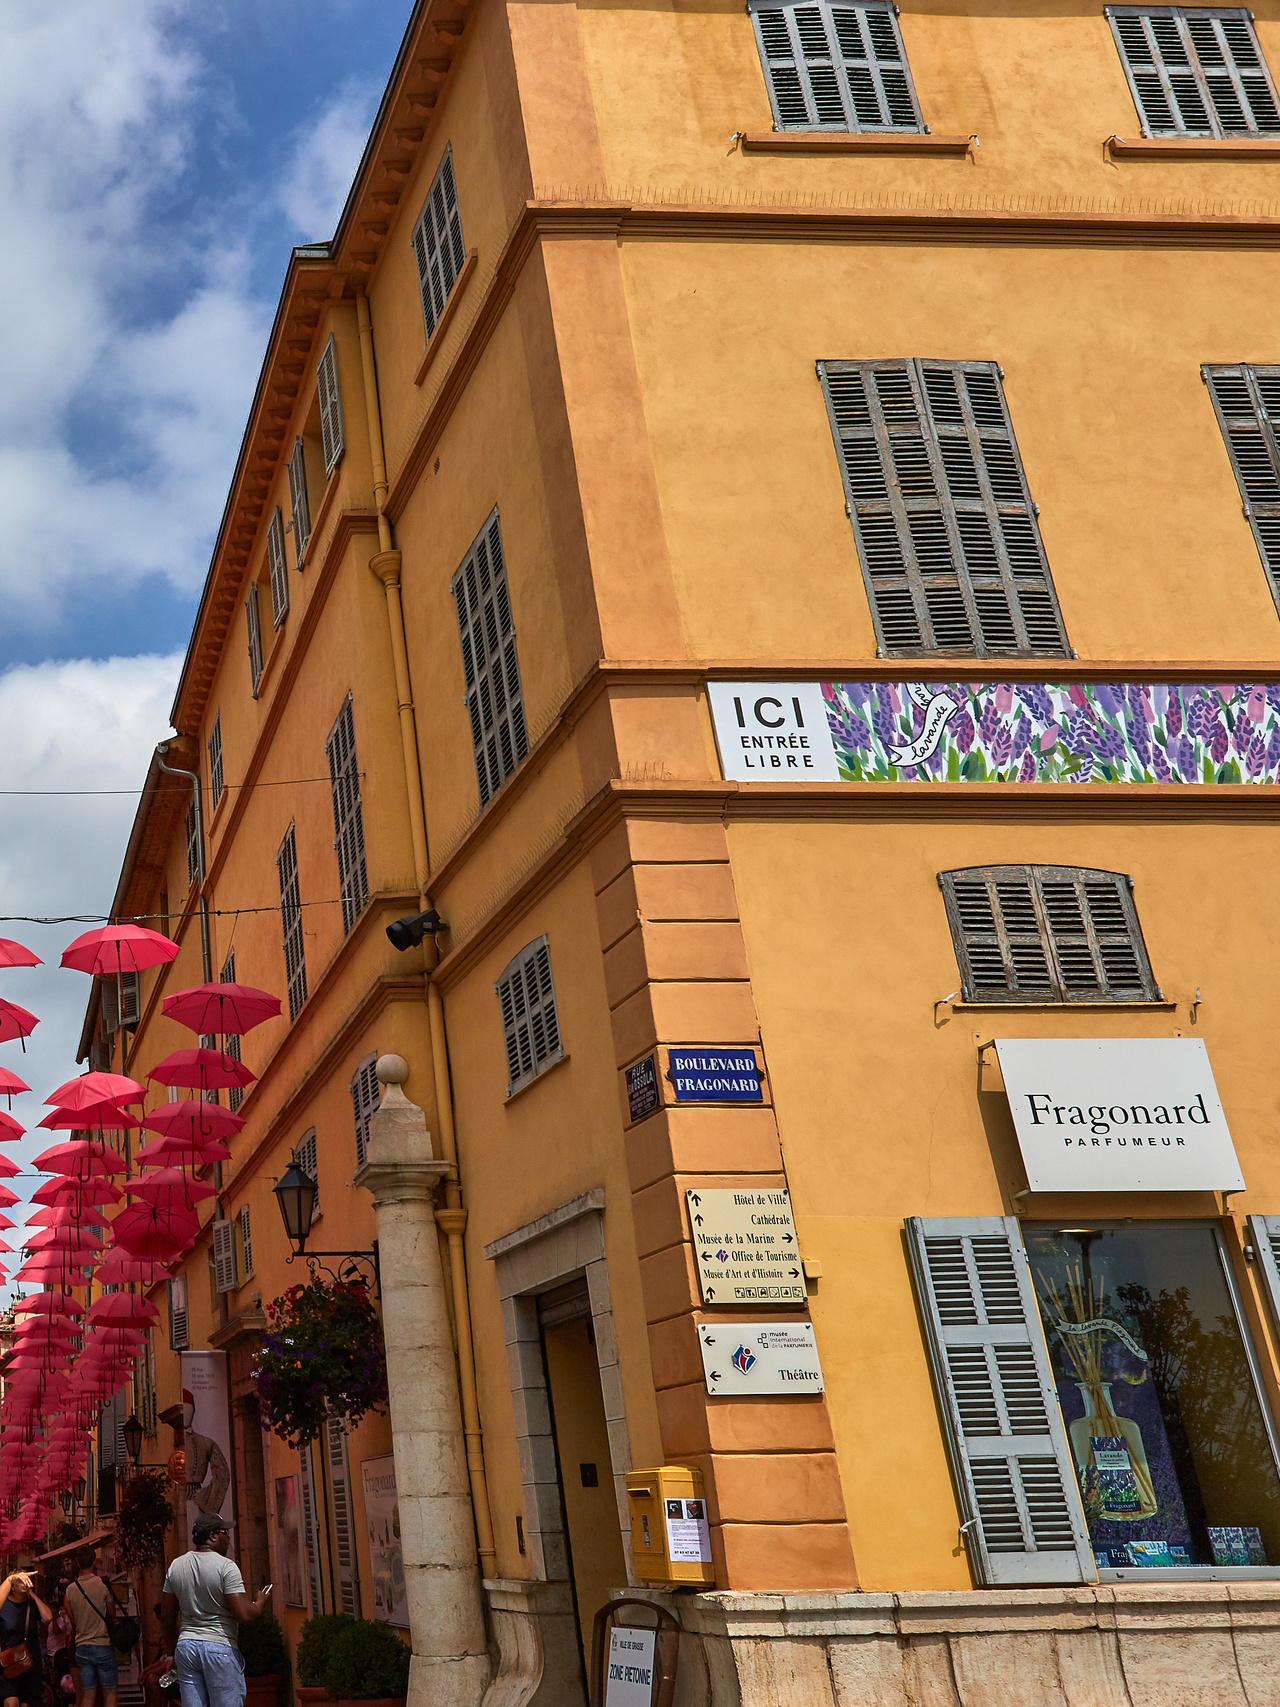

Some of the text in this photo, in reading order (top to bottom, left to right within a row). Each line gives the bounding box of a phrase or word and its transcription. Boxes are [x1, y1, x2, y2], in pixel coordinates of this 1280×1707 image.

[733, 696, 805, 729] ICI
[911, 705, 948, 761] lavande
[740, 732, 811, 749] ENTRÉE
[744, 754, 814, 768] LIBRE
[631, 1062, 646, 1080] RUE
[675, 1057, 755, 1071] BOULEVARD
[675, 1078, 759, 1092] FRAGONARD
[1024, 1093, 1211, 1135] Fragonard
[1064, 1137, 1186, 1147] PARFUMEUR
[733, 1194, 787, 1206] Hôtel de Ville
[750, 1214, 791, 1226] Cathédrale
[697, 1233, 775, 1245] Musée de la Marine
[731, 1250, 798, 1262] Office de Tourisme
[703, 1268, 784, 1279] Musée d'Art et d'Histoire
[778, 1369, 819, 1381] Théâtre
[609, 1663, 624, 1681] ZONE
